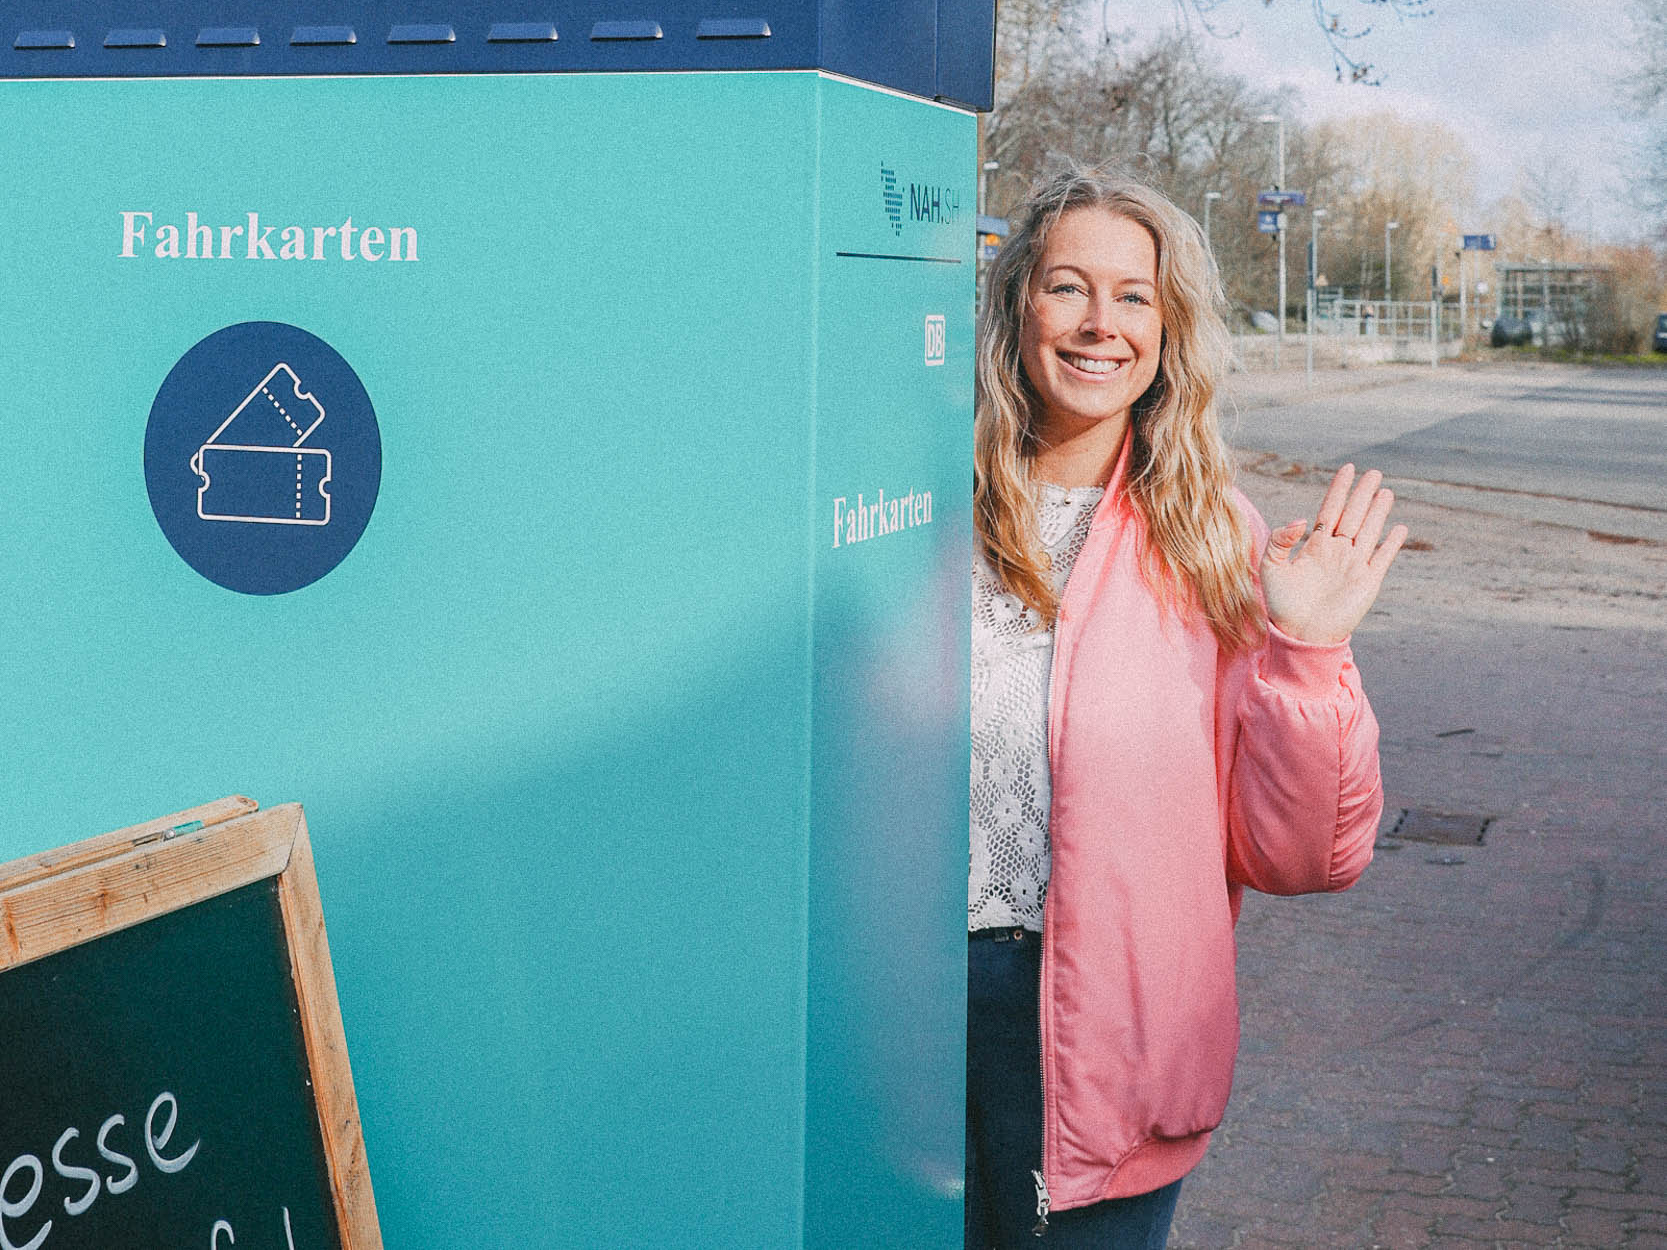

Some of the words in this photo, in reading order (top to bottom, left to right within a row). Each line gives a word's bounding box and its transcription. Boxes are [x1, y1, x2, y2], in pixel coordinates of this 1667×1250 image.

[910, 183, 960, 225] NAH.SH
[117, 211, 420, 262] Fahrkarten
[927, 320, 944, 360] DB
[832, 486, 933, 549] Fahrkarten
